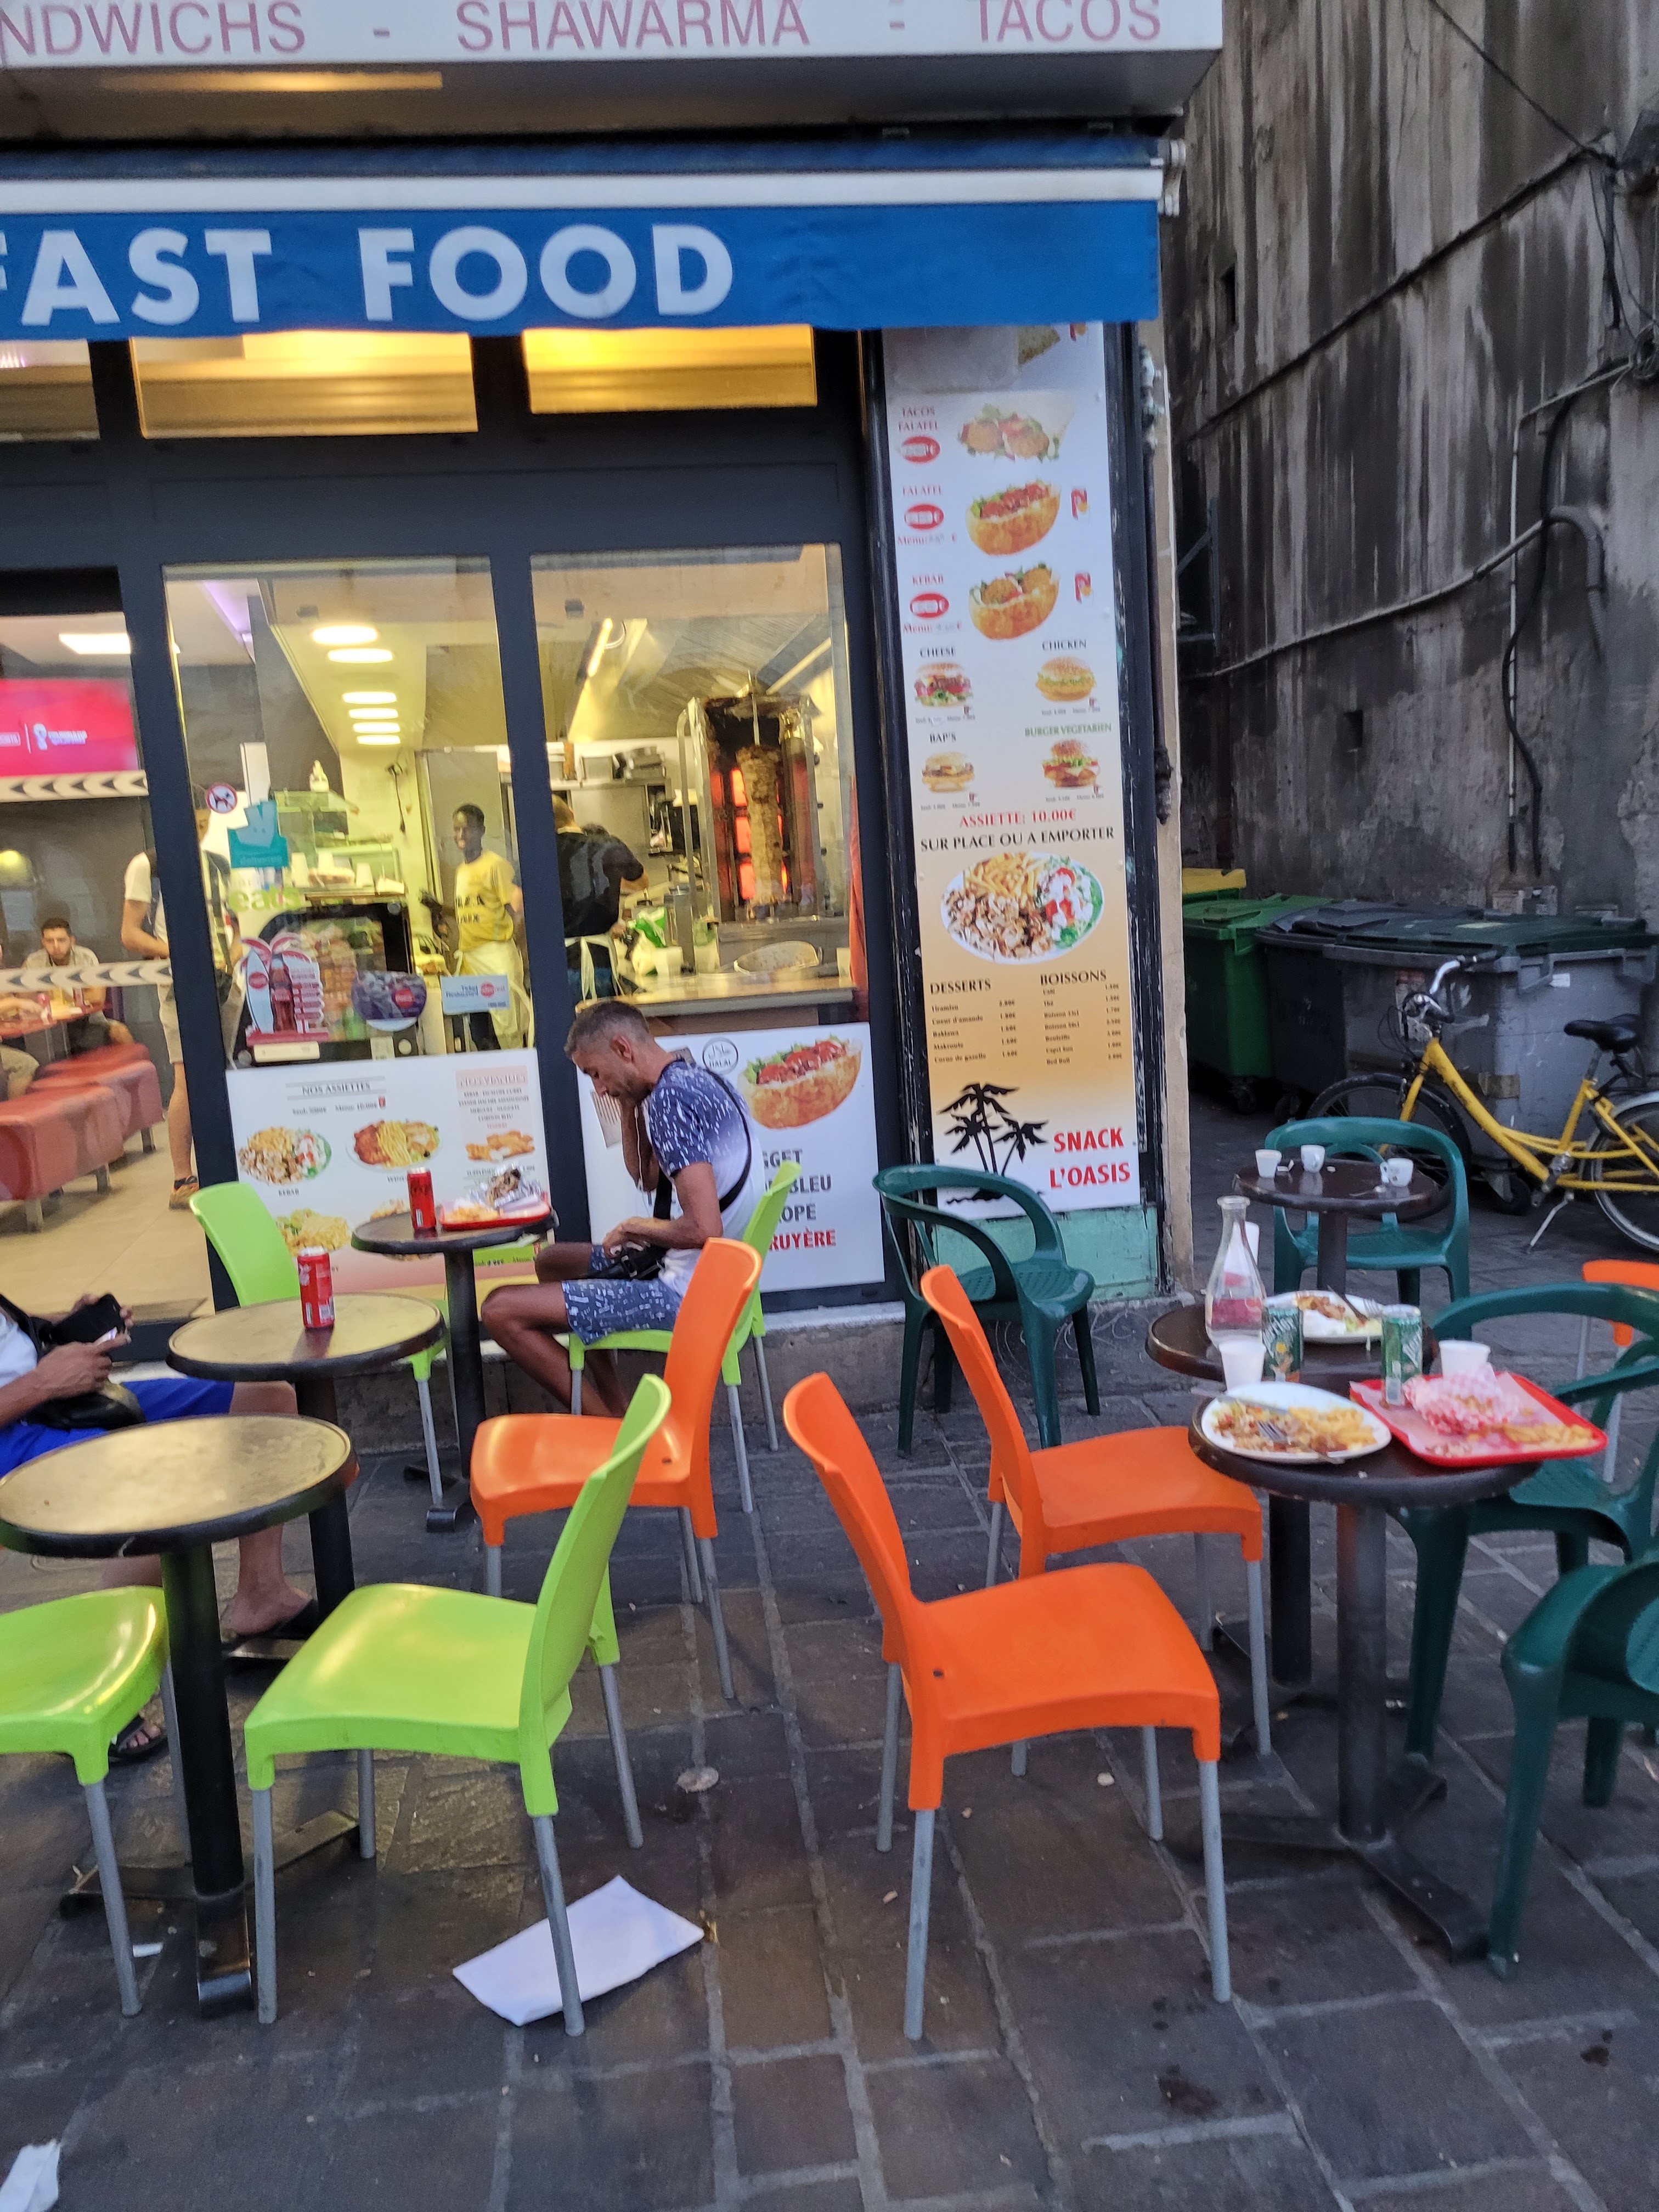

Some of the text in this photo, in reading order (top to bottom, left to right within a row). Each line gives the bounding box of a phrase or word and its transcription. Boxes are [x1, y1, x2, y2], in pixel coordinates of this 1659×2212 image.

[455, 0, 811, 53] SHAWARMA
[976, 0, 1161, 42] TACOS
[0, 223, 733, 326] AST FOOD
[1042, 639, 1087, 651] CHICKEN
[929, 732, 957, 743] BAP'S
[1024, 726, 1060, 737] BURGER
[960, 808, 1077, 828] ASSIETTE: 10.00€
[921, 826, 1115, 852] SUR PLACE OU A EMPORTER
[930, 978, 991, 996] DESSERTS
[1040, 969, 1107, 986] BOISSONS
[302, 1085, 324, 1096] NOS
[1053, 1127, 1125, 1154] SNACK
[1049, 1160, 1132, 1190] L'OASIS
[780, 1203, 817, 1223] OPE
